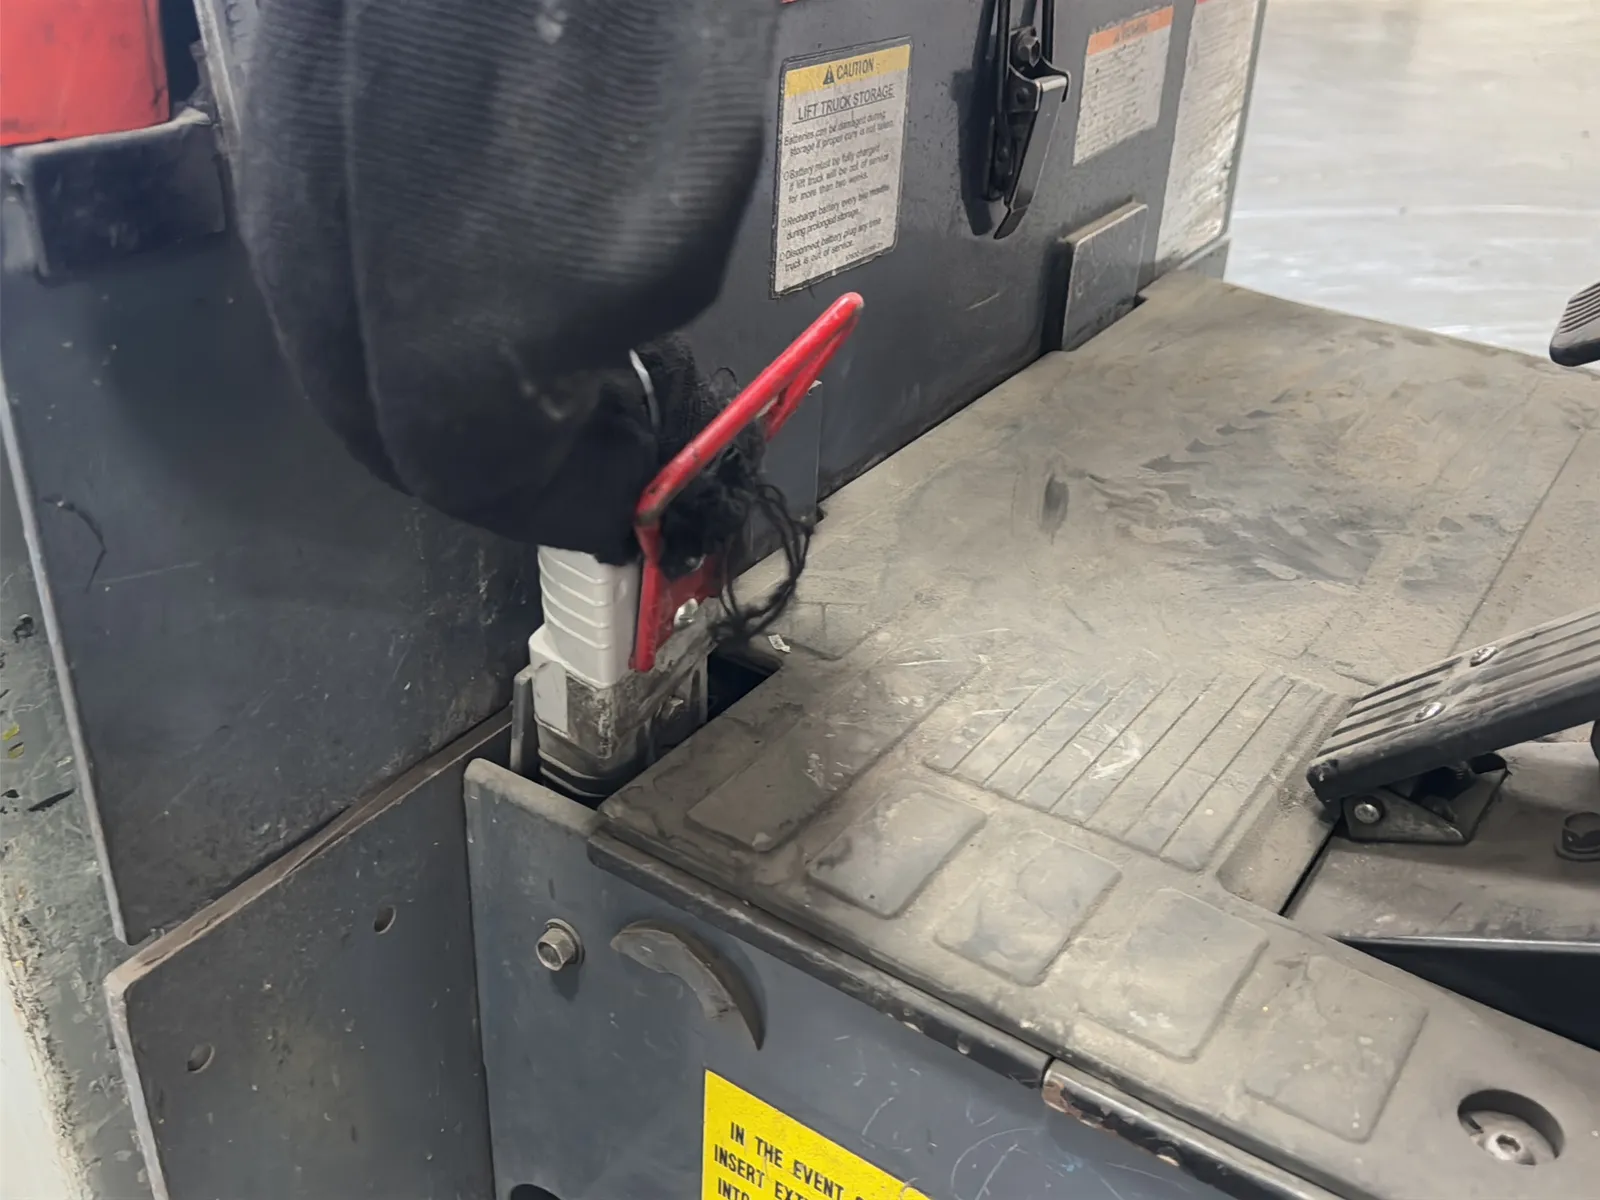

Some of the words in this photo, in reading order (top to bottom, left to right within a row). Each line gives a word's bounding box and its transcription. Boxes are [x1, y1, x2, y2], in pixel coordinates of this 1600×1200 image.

[836, 58, 874, 79] CAUTION
[798, 101, 820, 120] LIFT
[821, 94, 851, 113] TRUCK
[853, 84, 895, 106] STORAGE
[784, 131, 815, 146] Batteries
[815, 127, 827, 137] can
[829, 124, 837, 134] be
[790, 142, 815, 157] storage
[822, 134, 844, 149] proper
[789, 165, 814, 179] Battery
[814, 159, 831, 171] must
[832, 156, 840, 167] be
[807, 174, 823, 185] truck
[838, 166, 848, 176] be
[789, 195, 799, 204] for
[800, 189, 817, 200] more
[819, 183, 834, 194] than
[787, 210, 817, 225] Recharge
[818, 202, 840, 215] battery
[841, 196, 857, 208] every
[786, 227, 806, 241] during
[807, 214, 837, 233] prolonged
[786, 240, 821, 259] Disconnect
[821, 232, 842, 246] battery
[843, 227, 857, 238] plug
[784, 258, 802, 272] truck
[810, 251, 822, 262] out
[714, 1144, 765, 1189] INSERT
[775, 1180, 808, 1200] EX
[730, 1121, 745, 1146] IN
[755, 1136, 784, 1169] THE
[793, 1159, 845, 1200] EVENT
